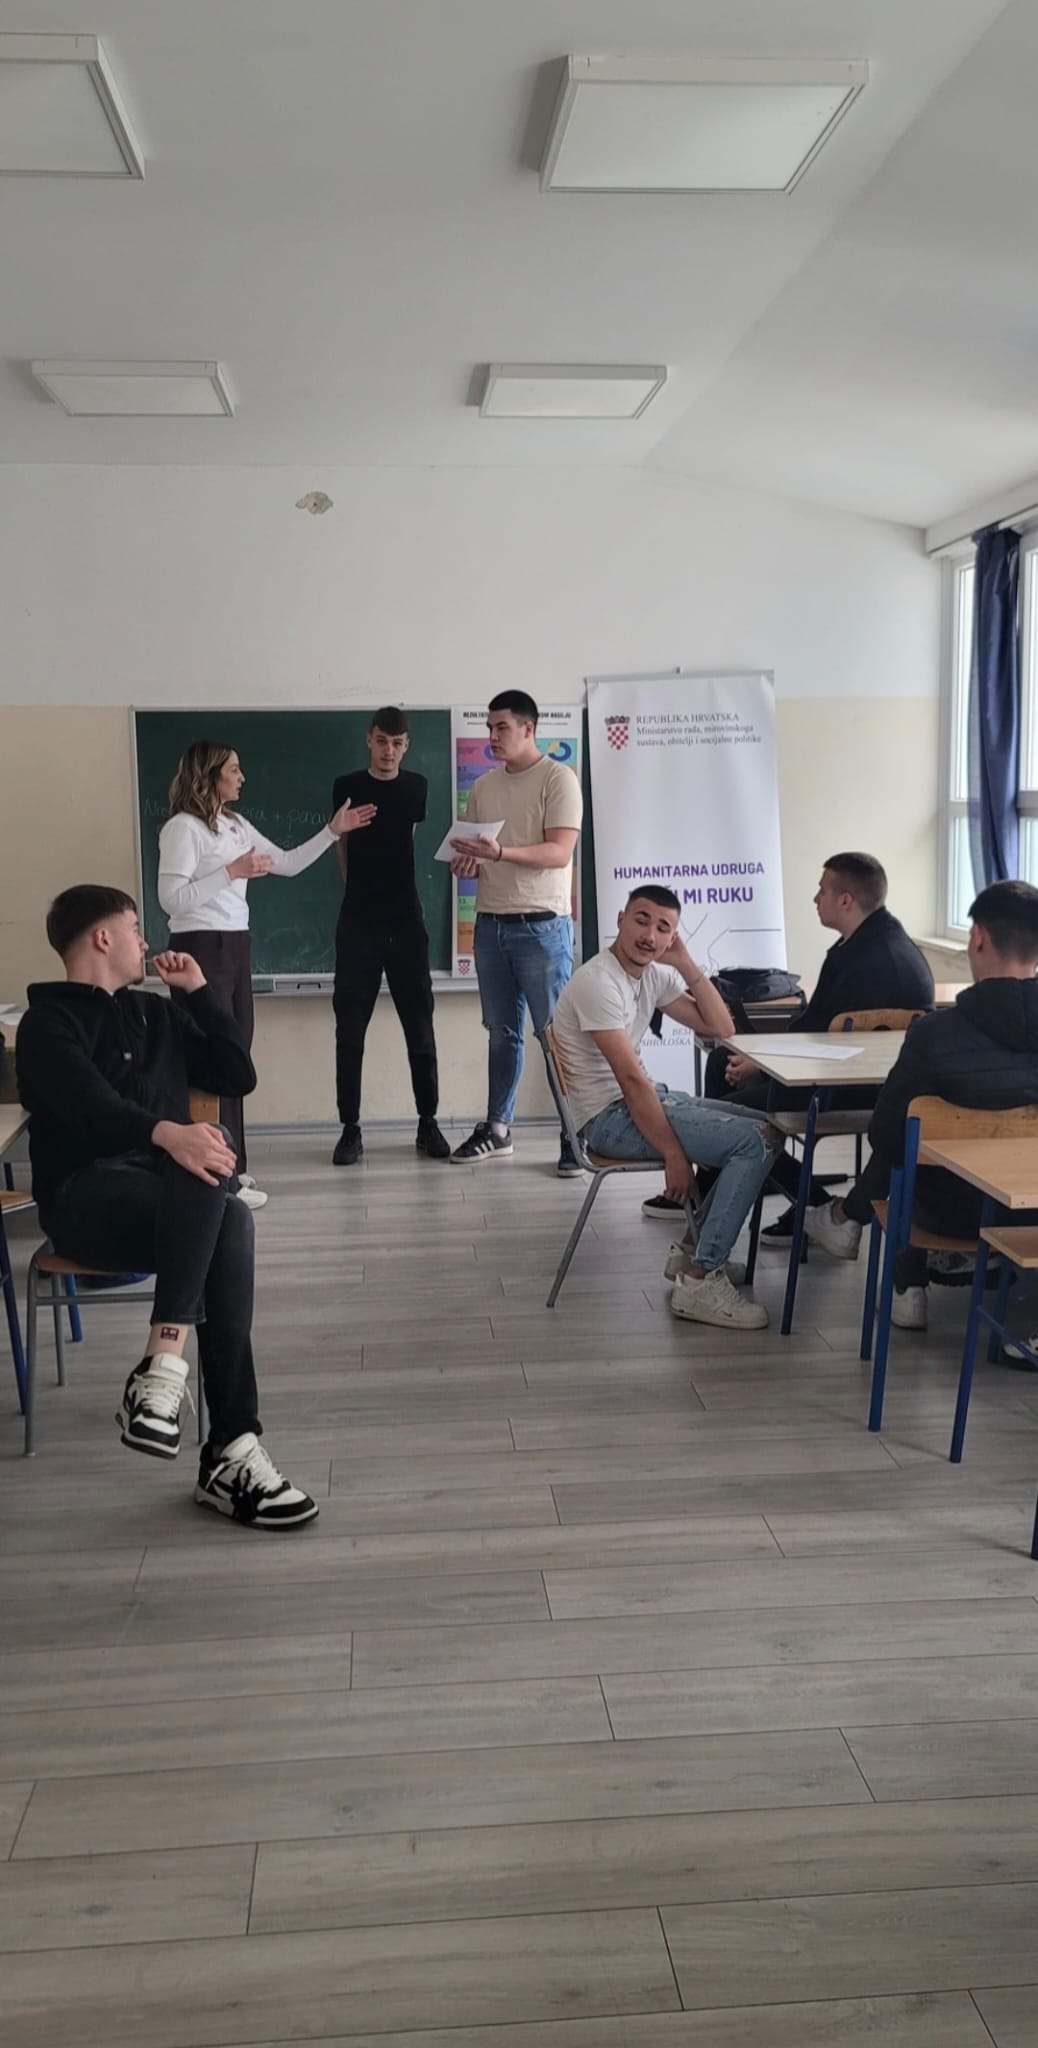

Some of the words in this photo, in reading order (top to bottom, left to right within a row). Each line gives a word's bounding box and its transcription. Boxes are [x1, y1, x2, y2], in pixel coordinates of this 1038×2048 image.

[636, 714, 690, 725] REPUBLIKA
[691, 712, 740, 723] HRVATSKA
[636, 726, 683, 735] Ministarstvo
[684, 724, 702, 734] rada,
[636, 738, 666, 747] sustava,
[733, 734, 762, 745] politike
[614, 864, 709, 880] HUMANITARNA
[711, 861, 765, 877] UDRUGA
[683, 888, 702, 905] MI
[707, 886, 754, 904] RUKU
